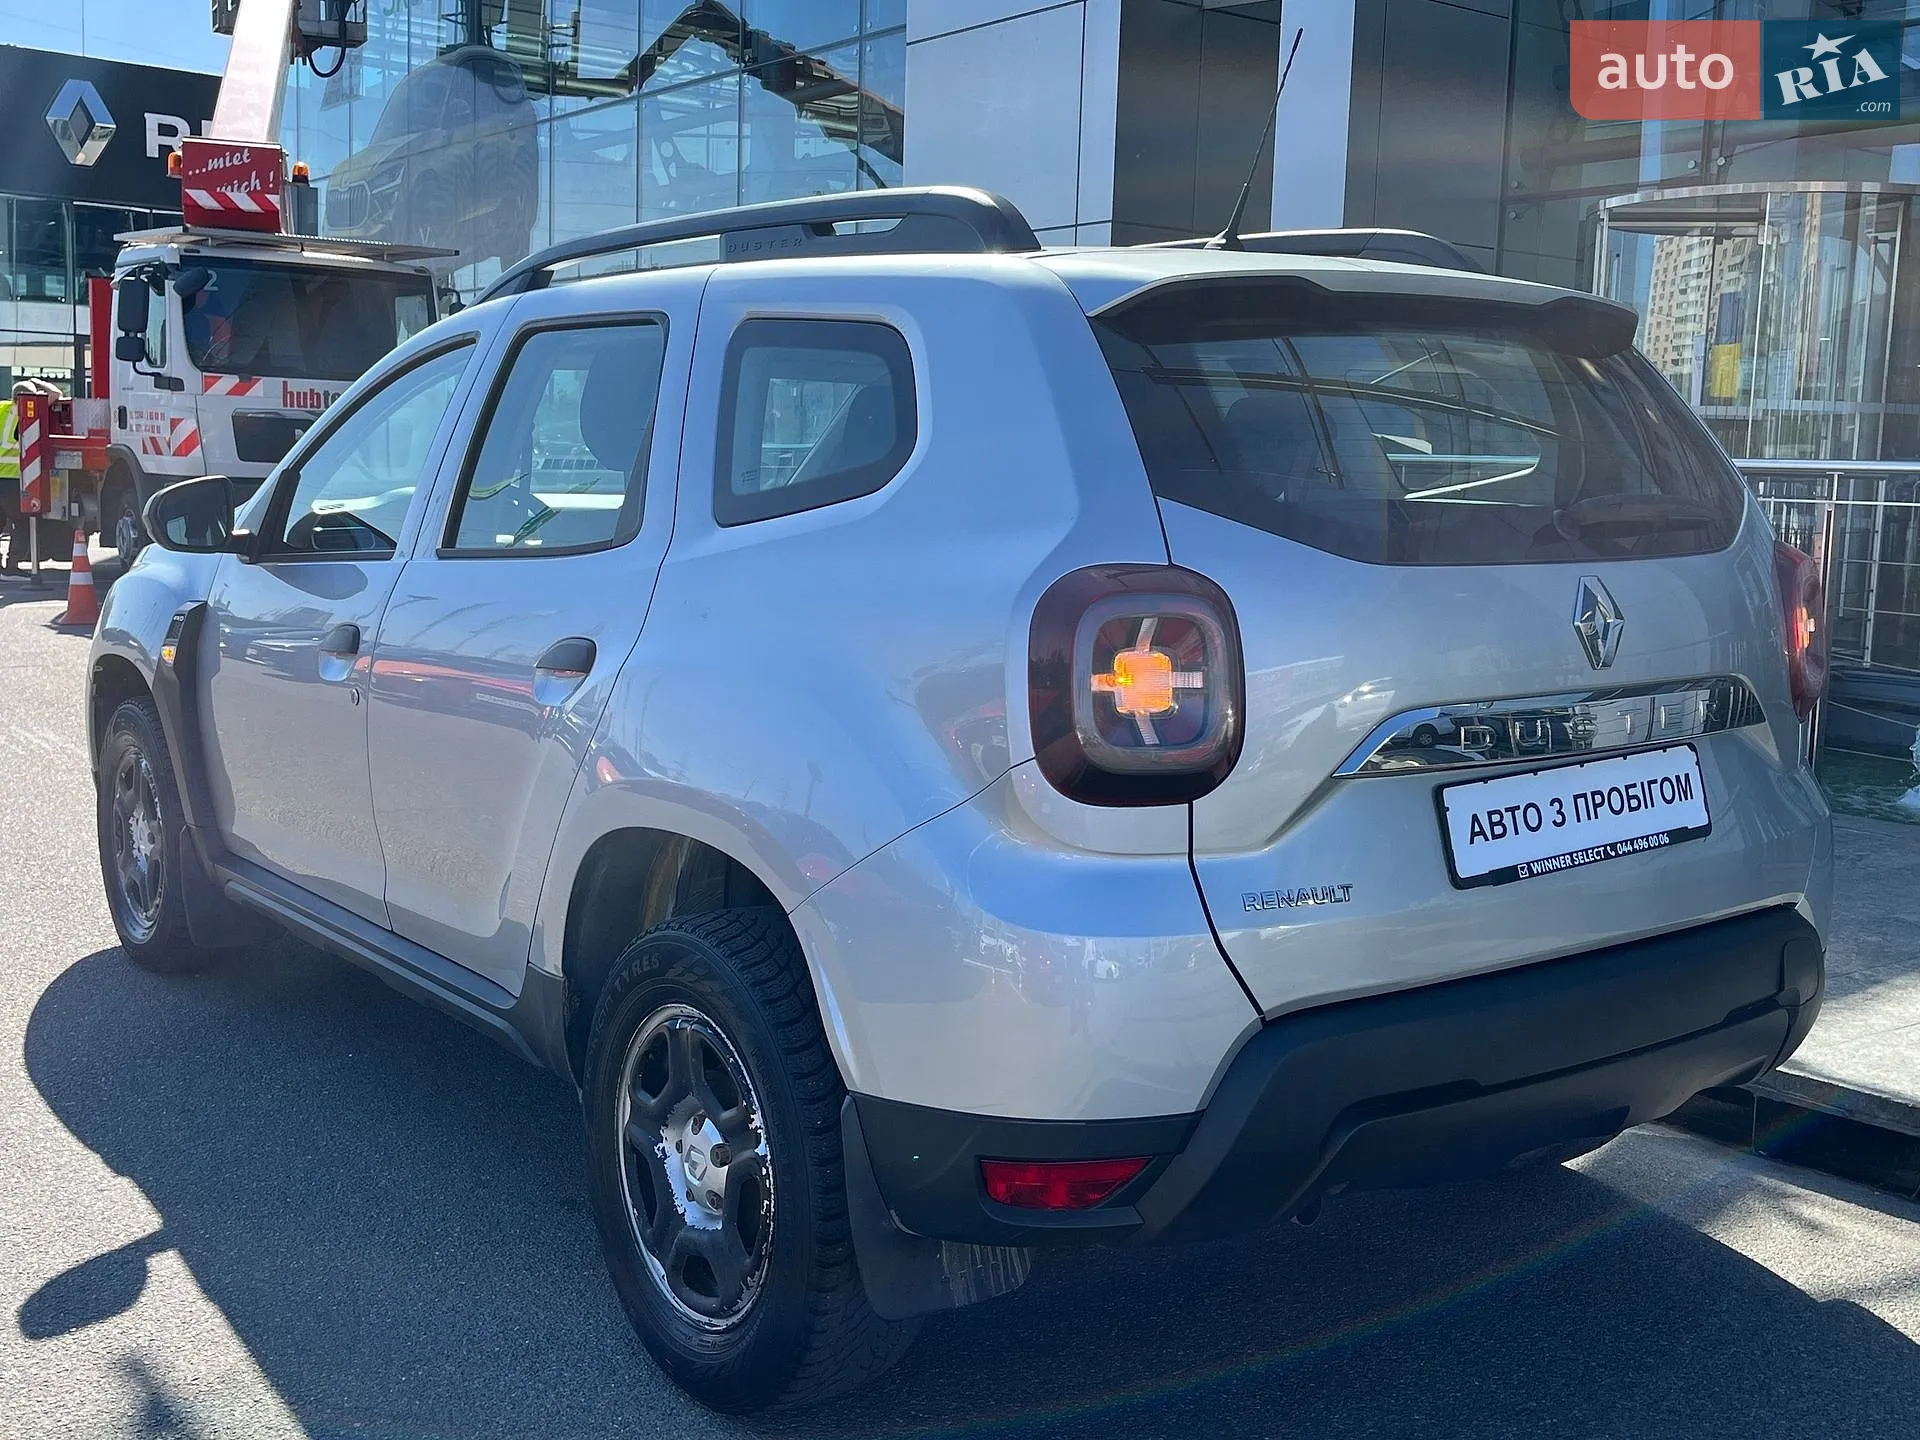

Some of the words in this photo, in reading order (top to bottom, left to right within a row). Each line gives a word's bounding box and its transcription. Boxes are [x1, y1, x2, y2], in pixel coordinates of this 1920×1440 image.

[144, 112, 212, 158] R
[727, 239, 803, 253] DUSTER
[1460, 699, 1720, 752] DUSTER
[1469, 802, 1543, 845] АВТО
[1573, 773, 1694, 823] ПРОБІГОМ
[1530, 855, 1573, 875] WINNER
[1573, 848, 1605, 865] SELECT
[1617, 842, 1633, 856] 044
[1634, 838, 1649, 851] 496
[1649, 835, 1659, 848] 00
[1659, 833, 1670, 846] 06
[1241, 883, 1353, 911] RENAULT
